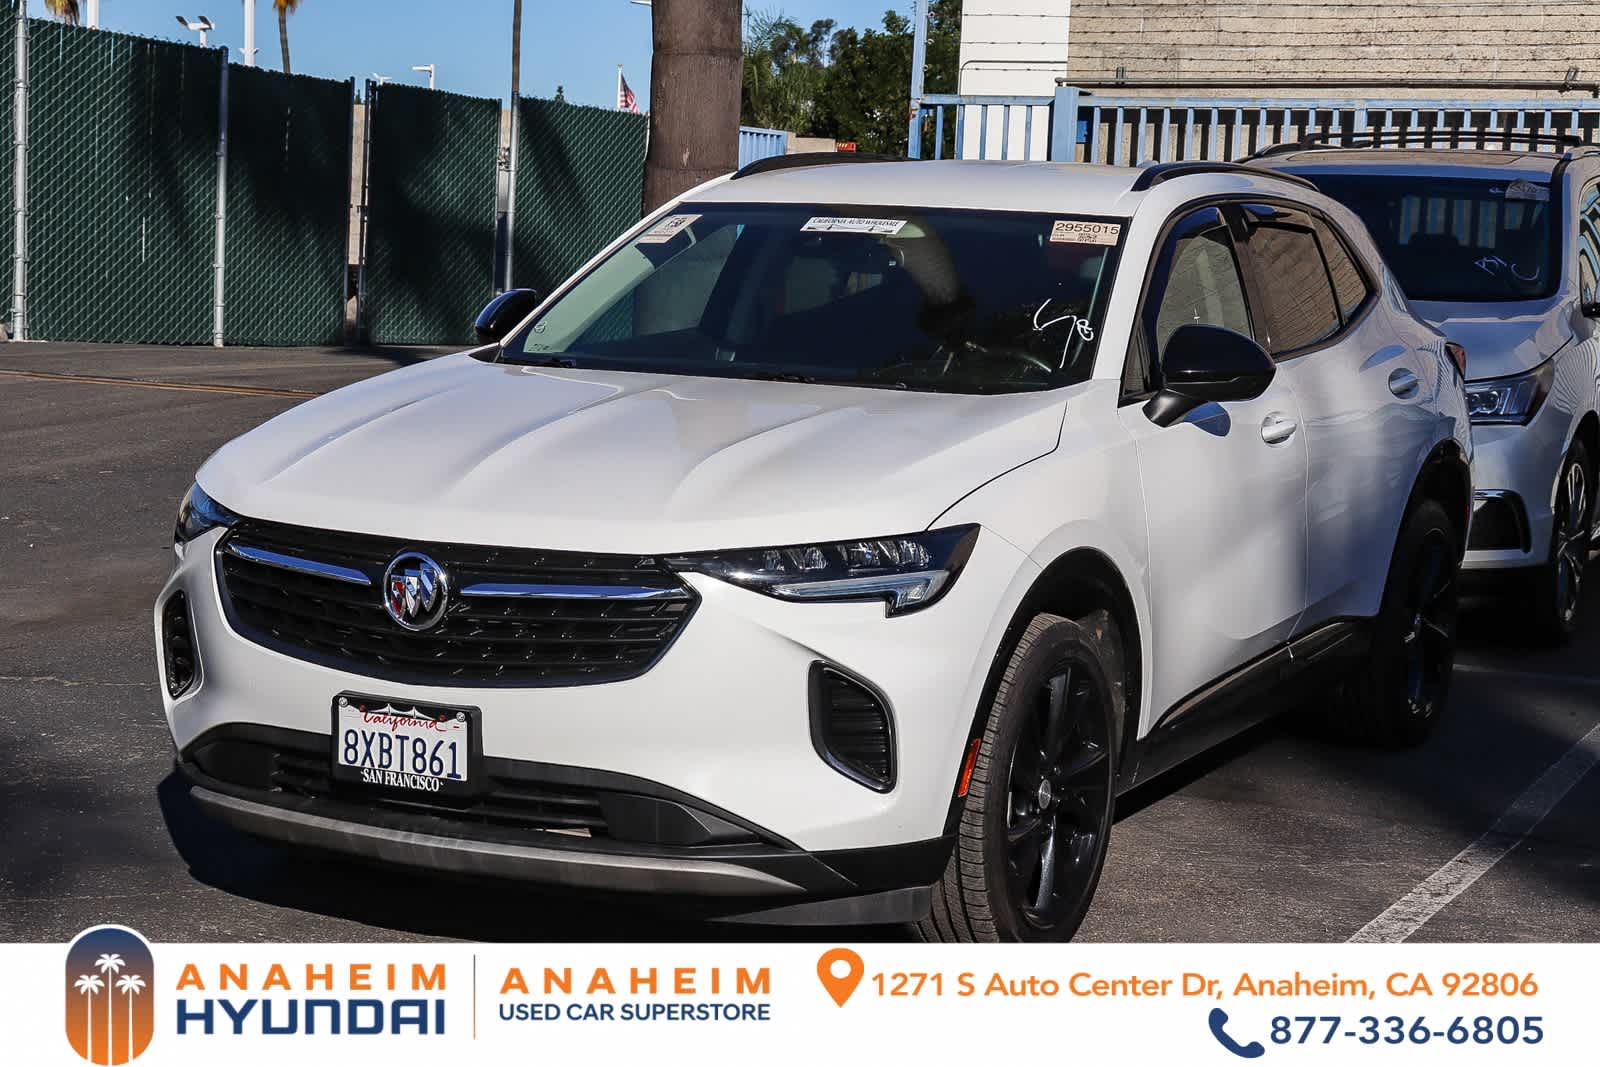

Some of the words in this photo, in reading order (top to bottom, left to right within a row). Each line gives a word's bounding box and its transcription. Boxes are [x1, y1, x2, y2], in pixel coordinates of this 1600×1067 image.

[1055, 222, 1119, 235] 2955015
[362, 710, 447, 732] California
[343, 729, 462, 780] 8XBT861
[362, 768, 383, 784] SAN
[385, 770, 440, 793] FRANCISCO
